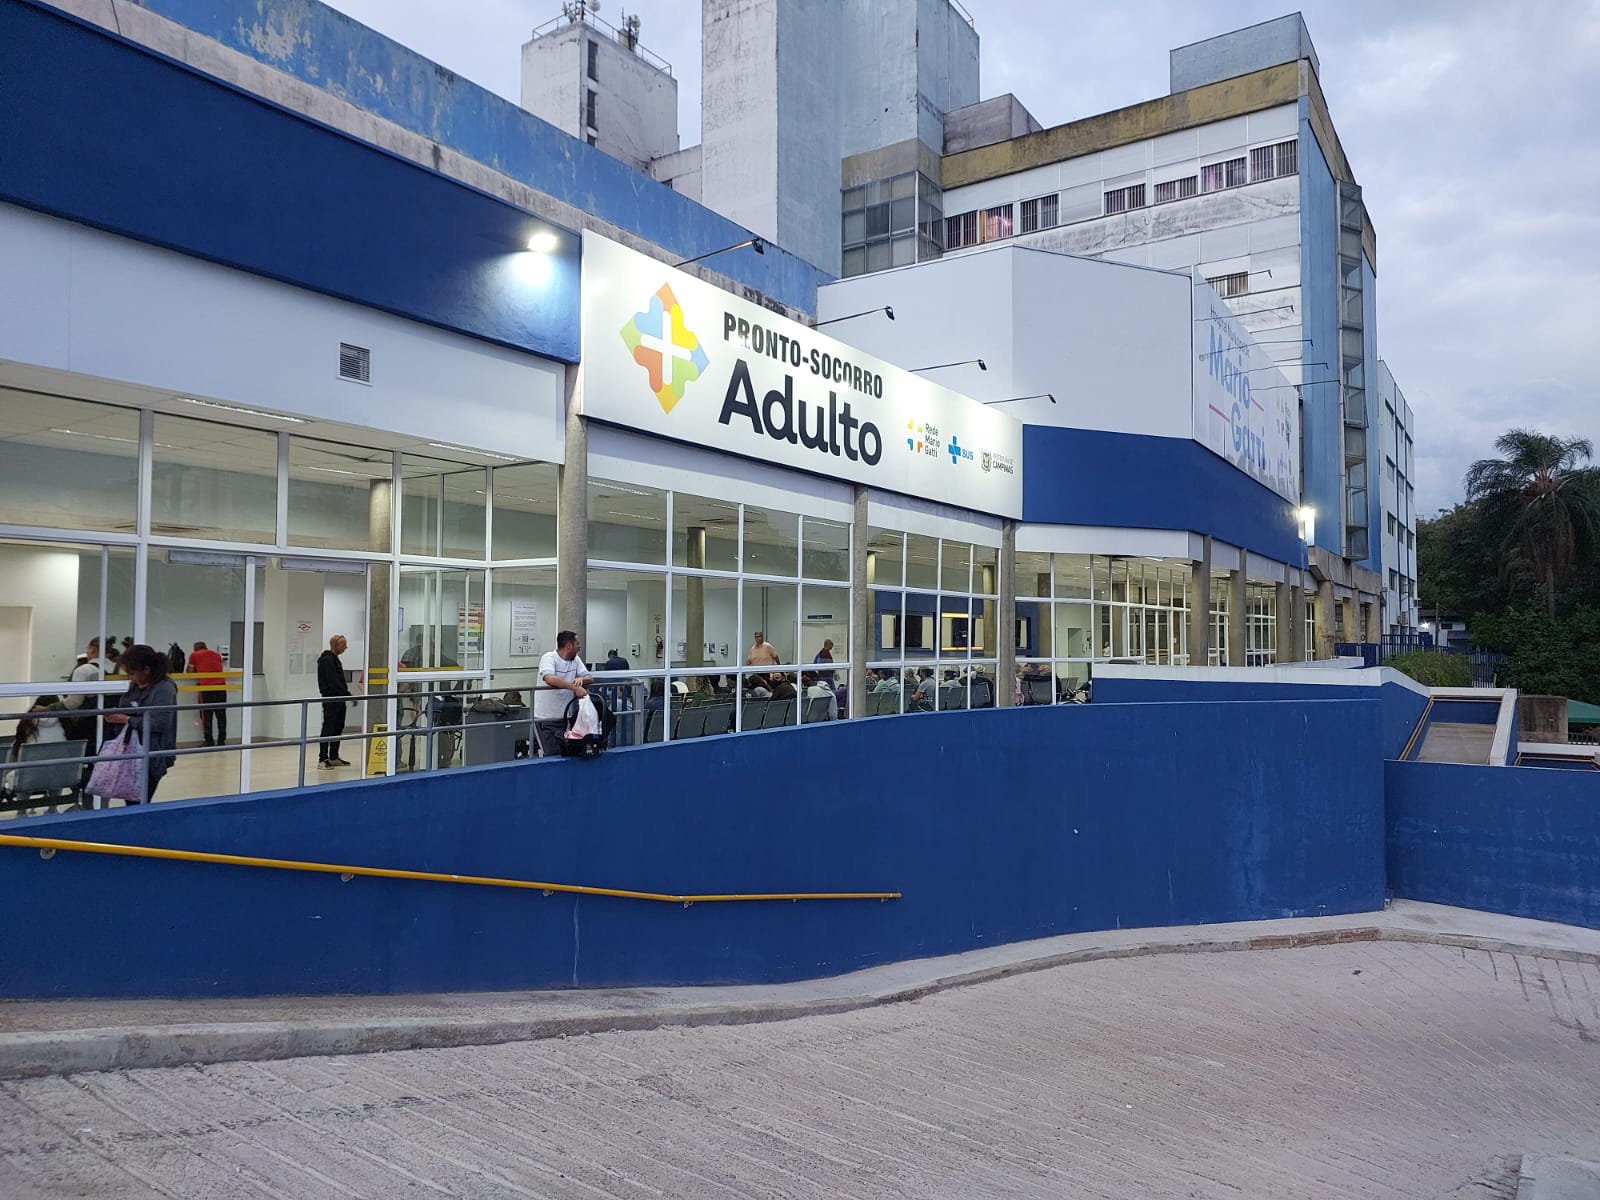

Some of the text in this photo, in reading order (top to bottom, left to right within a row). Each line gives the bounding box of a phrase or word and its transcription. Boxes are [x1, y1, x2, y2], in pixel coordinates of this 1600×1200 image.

[723, 311, 883, 399] PRONTO-SOCORRO
[718, 358, 882, 466] Adulto
[925, 422, 939, 436] Rede
[924, 445, 938, 458] Gatti
[962, 448, 974, 460] SUS
